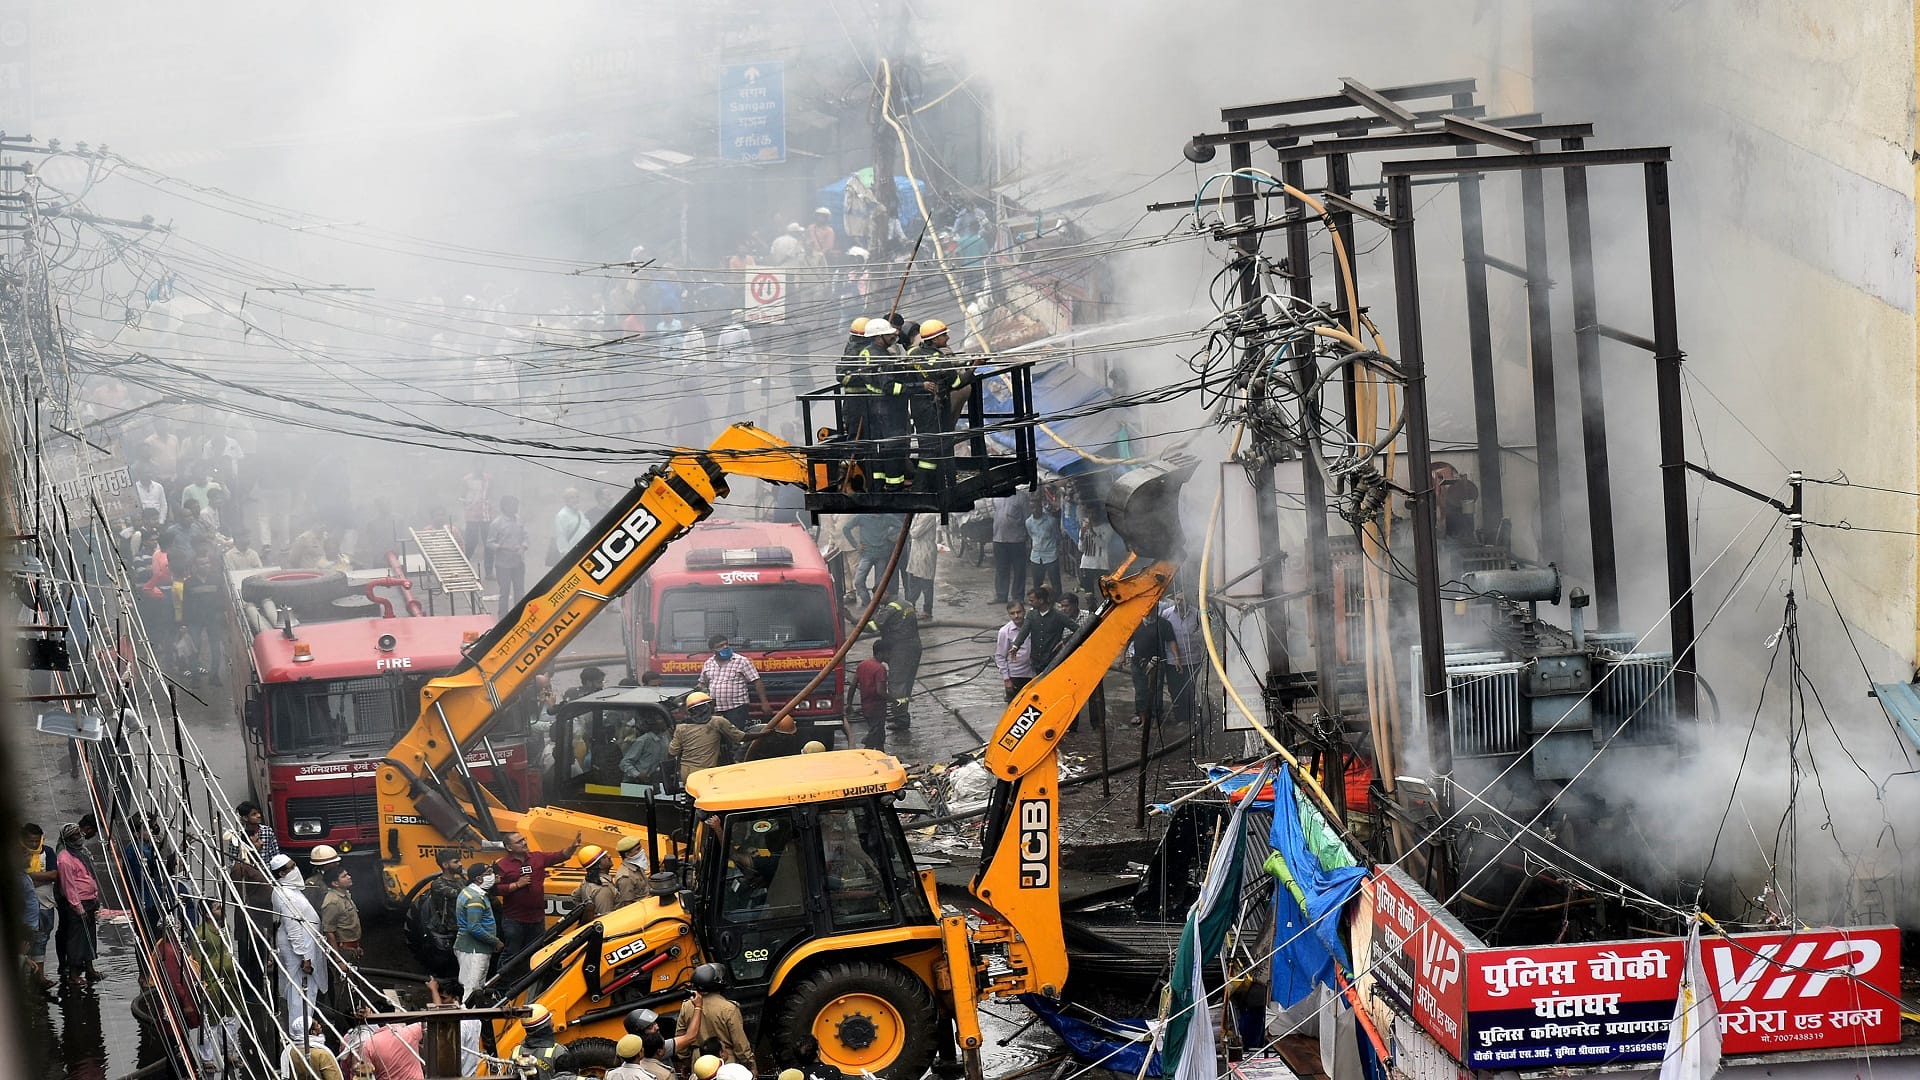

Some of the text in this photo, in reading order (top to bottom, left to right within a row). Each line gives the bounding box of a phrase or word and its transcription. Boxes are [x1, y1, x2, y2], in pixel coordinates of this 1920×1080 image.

[729, 101, 776, 112] Sangam
[591, 508, 657, 580] JCB
[717, 570, 760, 585] पुलिस
[515, 611, 580, 673] LOADALL
[376, 657, 412, 669] FIRE
[1010, 706, 1041, 738] 3DX
[300, 764, 349, 775] अग्निशमन
[1022, 801, 1048, 887] JCB
[1376, 880, 1415, 933] पुलिस चौकी
[607, 939, 647, 964] JCB
[744, 948, 769, 959] eco
[1422, 919, 1460, 994] VIP
[1481, 949, 1670, 997] पुलिस चौकी
[1713, 939, 1882, 1002] VIP
[1417, 983, 1437, 1019] अरोरा
[1531, 990, 1622, 1019] घंटाघर
[1478, 1019, 1673, 1047] पुलिस कमिश्नरेट प्रयागराज
[1828, 1008, 1884, 1029] सन्स
[1774, 1032, 1824, 1042] 7007438319
